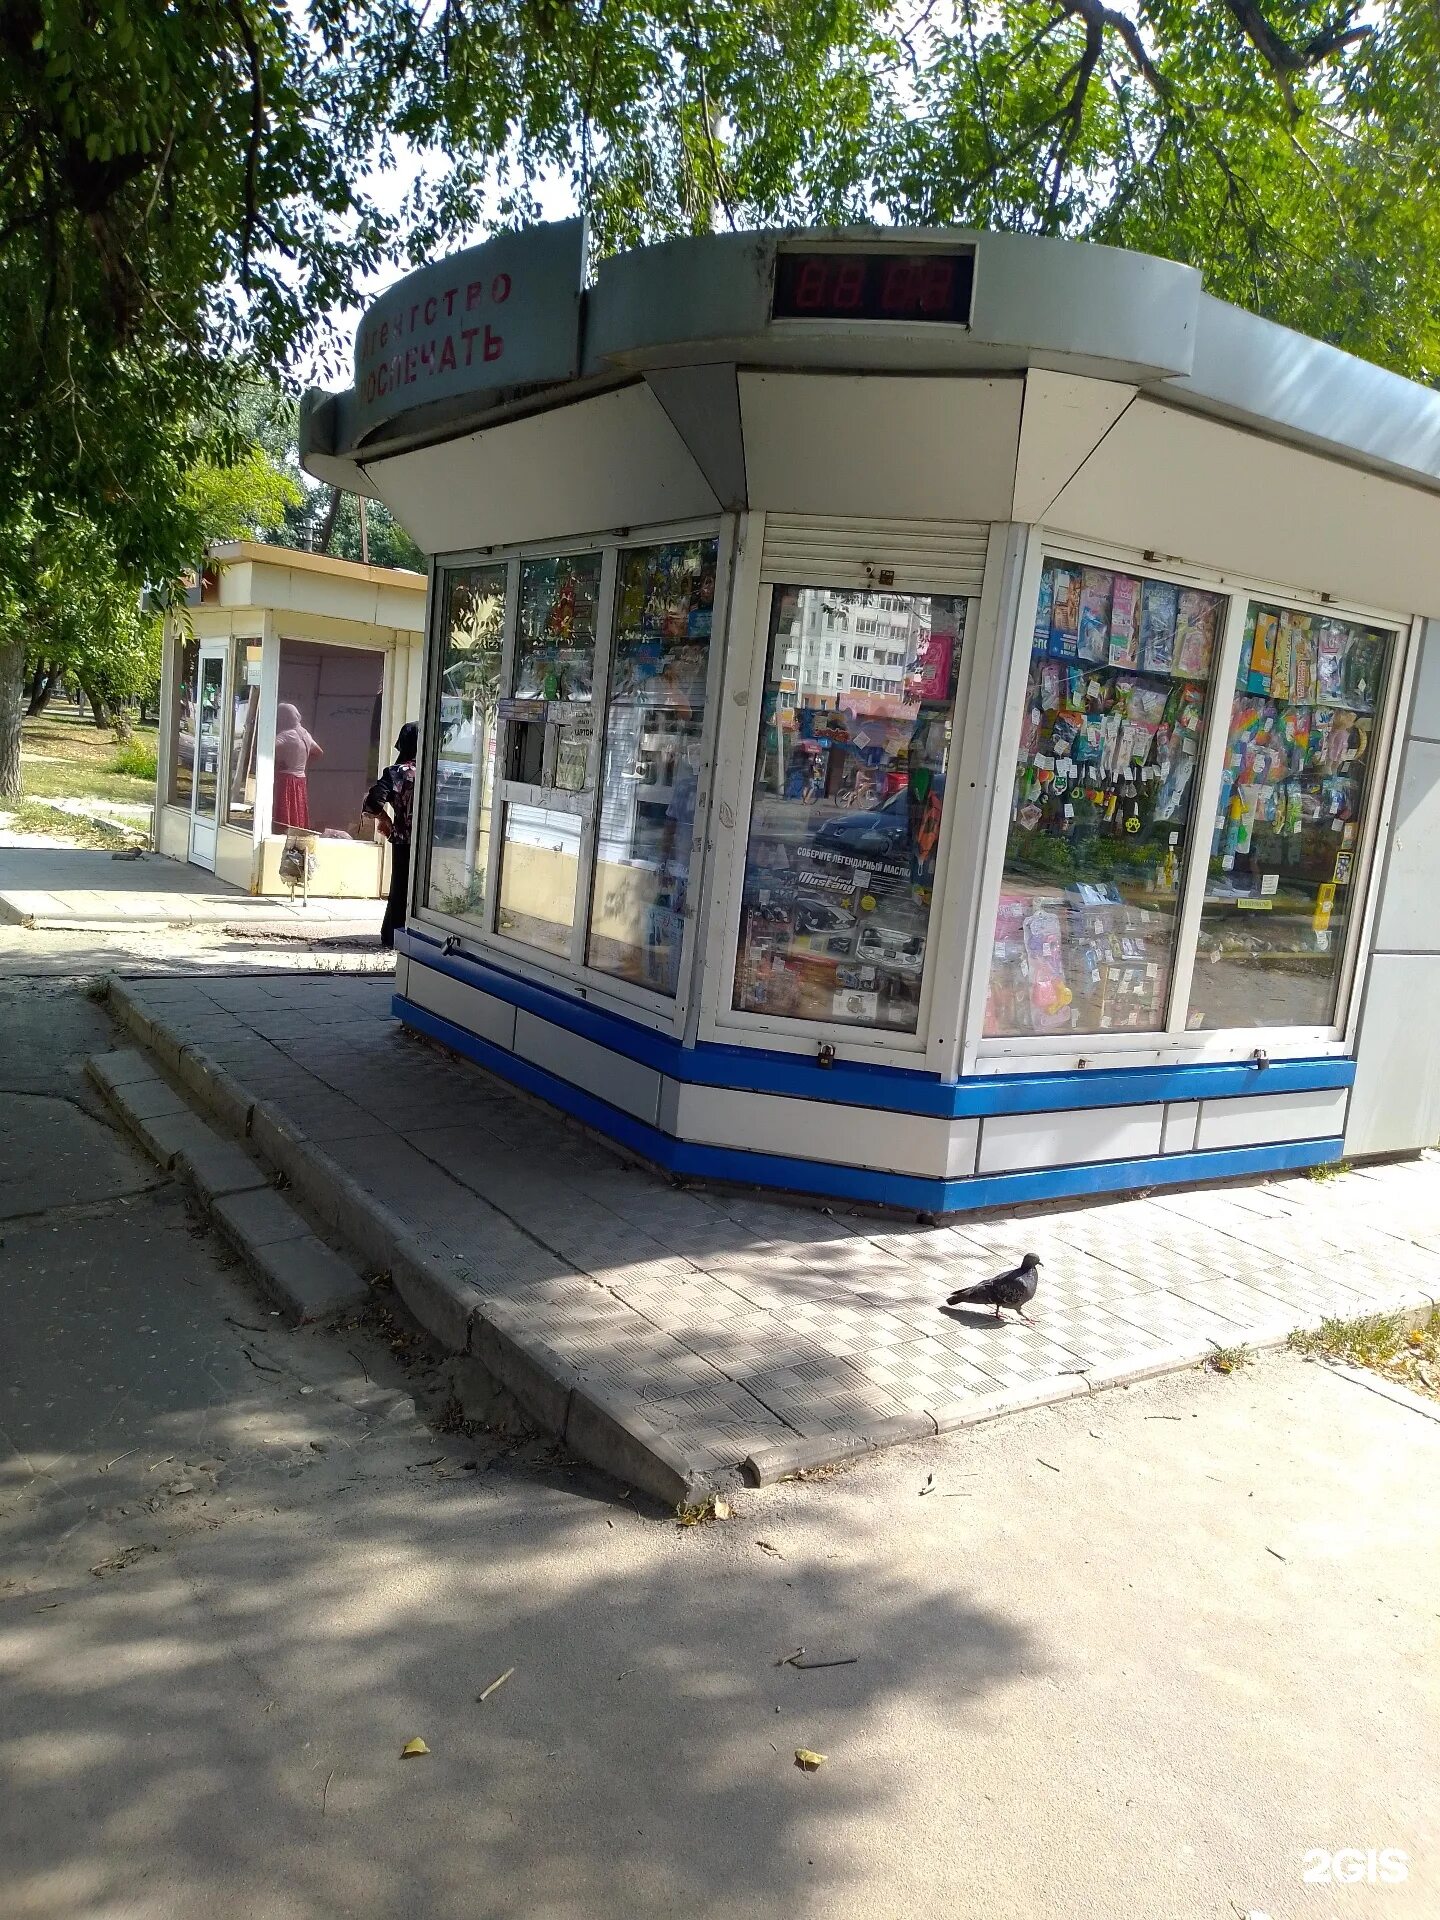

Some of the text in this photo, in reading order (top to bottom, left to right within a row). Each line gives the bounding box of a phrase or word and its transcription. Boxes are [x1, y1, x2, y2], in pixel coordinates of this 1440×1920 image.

[797, 847, 832, 862] СОБЕРИТЕ
[832, 854, 883, 871] ЛЕГЕНДАРНЫЙ
[798, 871, 857, 895] Mustang
